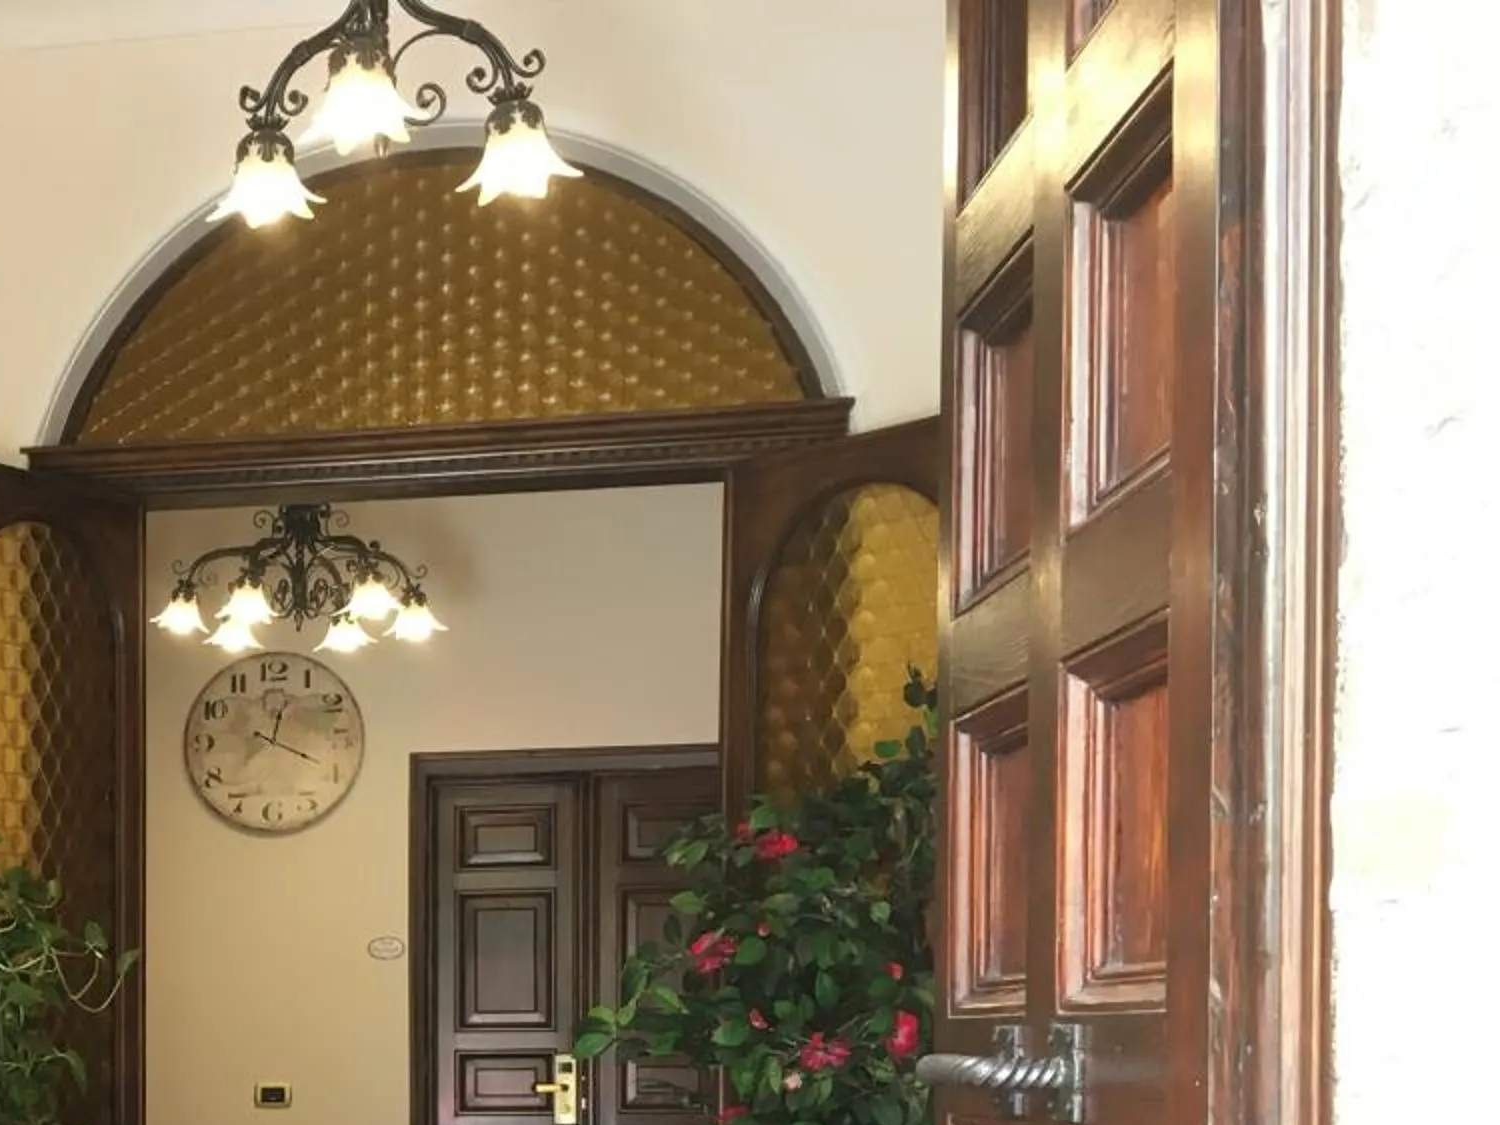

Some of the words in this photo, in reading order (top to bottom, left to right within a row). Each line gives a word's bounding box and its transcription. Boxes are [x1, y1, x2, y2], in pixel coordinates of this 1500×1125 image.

[260, 660, 289, 683] 12
[304, 669, 312, 689] 1
[230, 673, 247, 694] 11
[204, 699, 228, 721] 10
[321, 693, 343, 713] 2
